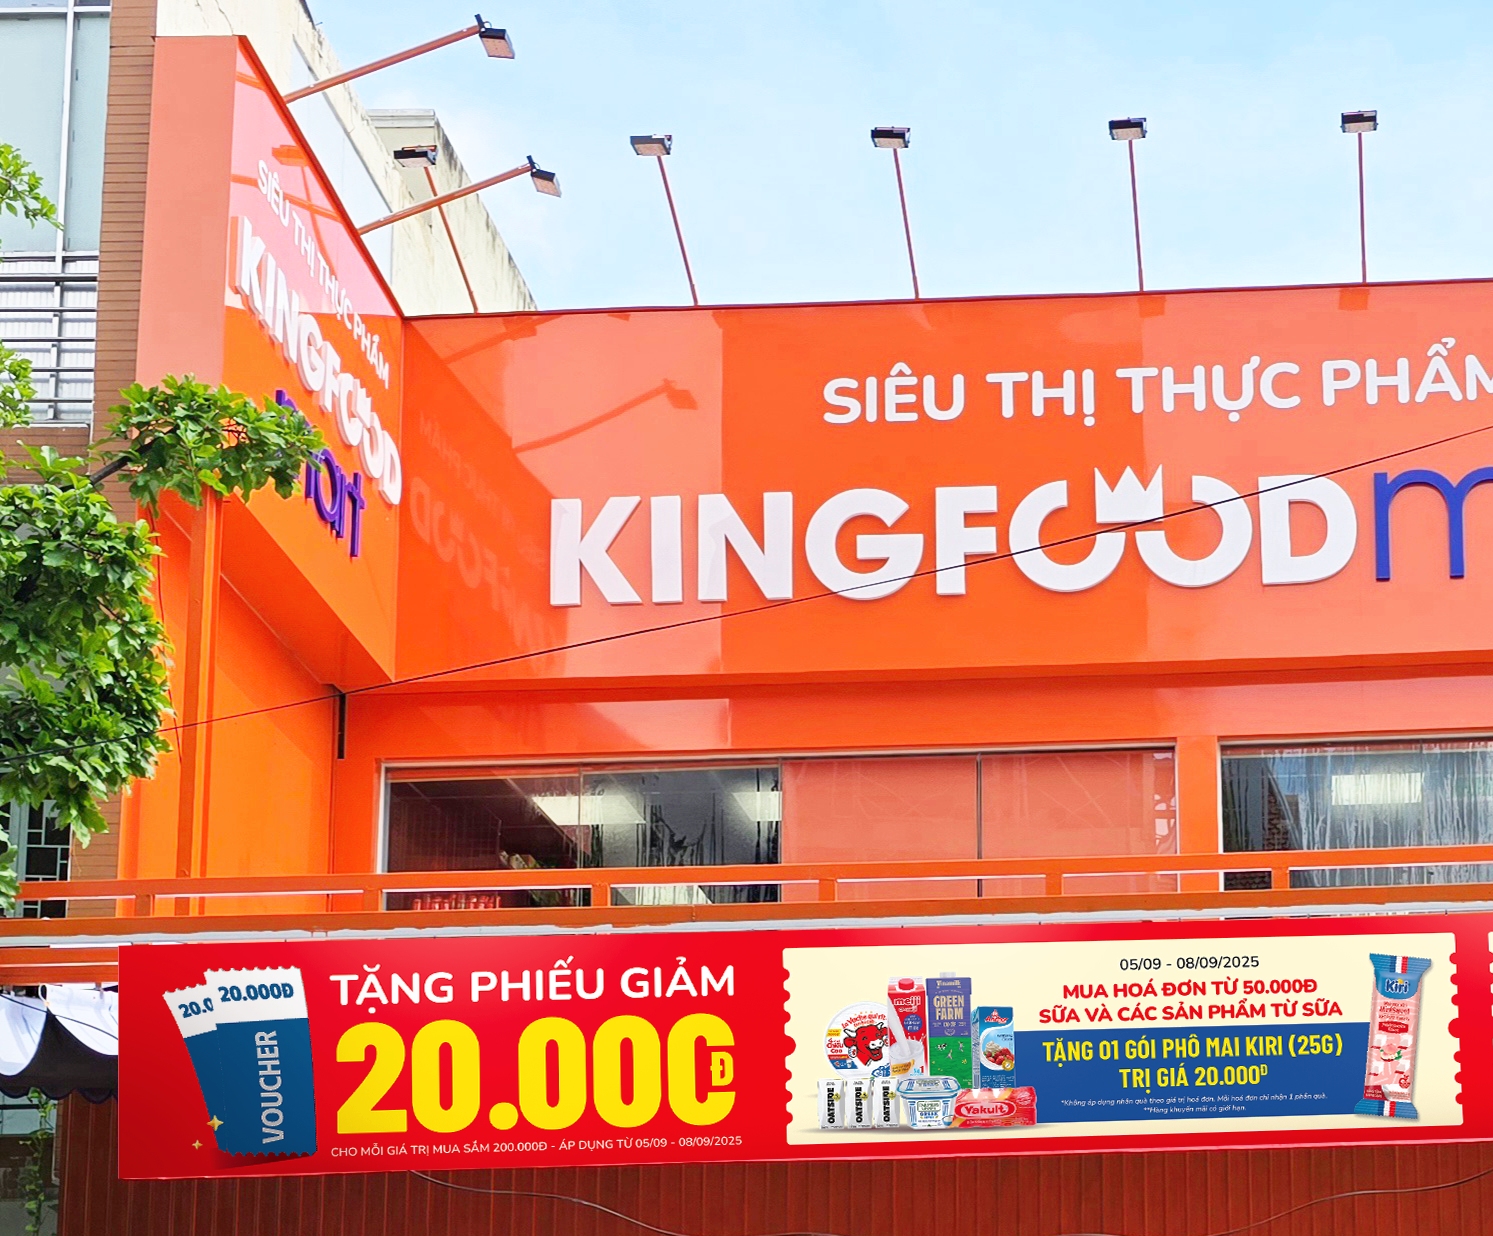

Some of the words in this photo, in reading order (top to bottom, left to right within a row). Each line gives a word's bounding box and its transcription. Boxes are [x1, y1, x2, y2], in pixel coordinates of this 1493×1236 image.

[257, 159, 290, 228] SIÊU
[292, 226, 315, 277] THỊ
[316, 254, 354, 331] THỰC
[230, 214, 402, 507] KINGFOOD
[823, 362, 965, 424] SIÊU
[986, 368, 1096, 427] THỊ
[1115, 358, 1301, 423] THỰC
[1119, 958, 1162, 971] 05/09
[1176, 956, 1260, 970] 08/09/2025
[217, 981, 295, 1004] 20.000Đ
[329, 963, 454, 1014] TẶNG
[473, 953, 605, 1004] PHIẾU
[619, 956, 735, 1000] GIẢM
[1063, 984, 1108, 999] MUA
[1114, 978, 1158, 998] HOÁ
[1162, 979, 1207, 996] ĐƠN
[1211, 976, 1239, 995] TỪ
[1243, 978, 1318, 995] 50.000Đ
[1385, 978, 1410, 994] Kiri
[893, 996, 921, 1008] meiji
[933, 994, 965, 1008] GREEN
[1039, 1005, 1080, 1023] SỮA
[1084, 1004, 1113, 1022] VÀ
[1117, 1002, 1158, 1022] CÁC
[1162, 1001, 1203, 1020] SẢN
[1208, 998, 1266, 1019] PHẨM
[1271, 999, 1298, 1018] TỪ
[1302, 998, 1343, 1017] SỮA
[935, 1008, 964, 1021] FARM
[1042, 1038, 1093, 1068] TẶNG
[1099, 1041, 1119, 1060] 01
[1125, 1035, 1156, 1059] GÓI
[1162, 1033, 1200, 1059] PHÔ
[1205, 1036, 1240, 1057] MAI
[1245, 1035, 1283, 1056] KIRI
[1288, 1033, 1343, 1057] (25G)
[260, 1030, 284, 1146] VOUCHER
[1119, 1067, 1151, 1094] TRỊ
[1157, 1062, 1188, 1087] GIÁ
[963, 1104, 1008, 1115] Yakult
[331, 1147, 358, 1158] CHO
[361, 1142, 384, 1157] MỖI
[386, 1143, 408, 1156] GIÁ
[410, 1144, 431, 1158] TRỊ
[433, 1144, 461, 1155] MUA
[493, 1141, 548, 1154] 200.000Đ
[558, 1137, 575, 1151] ÁP
[578, 1139, 614, 1152] DỤNG
[616, 1136, 634, 1150] TỪ
[635, 1137, 668, 1149] 05/09
[678, 1135, 743, 1149] 08/09/2025
